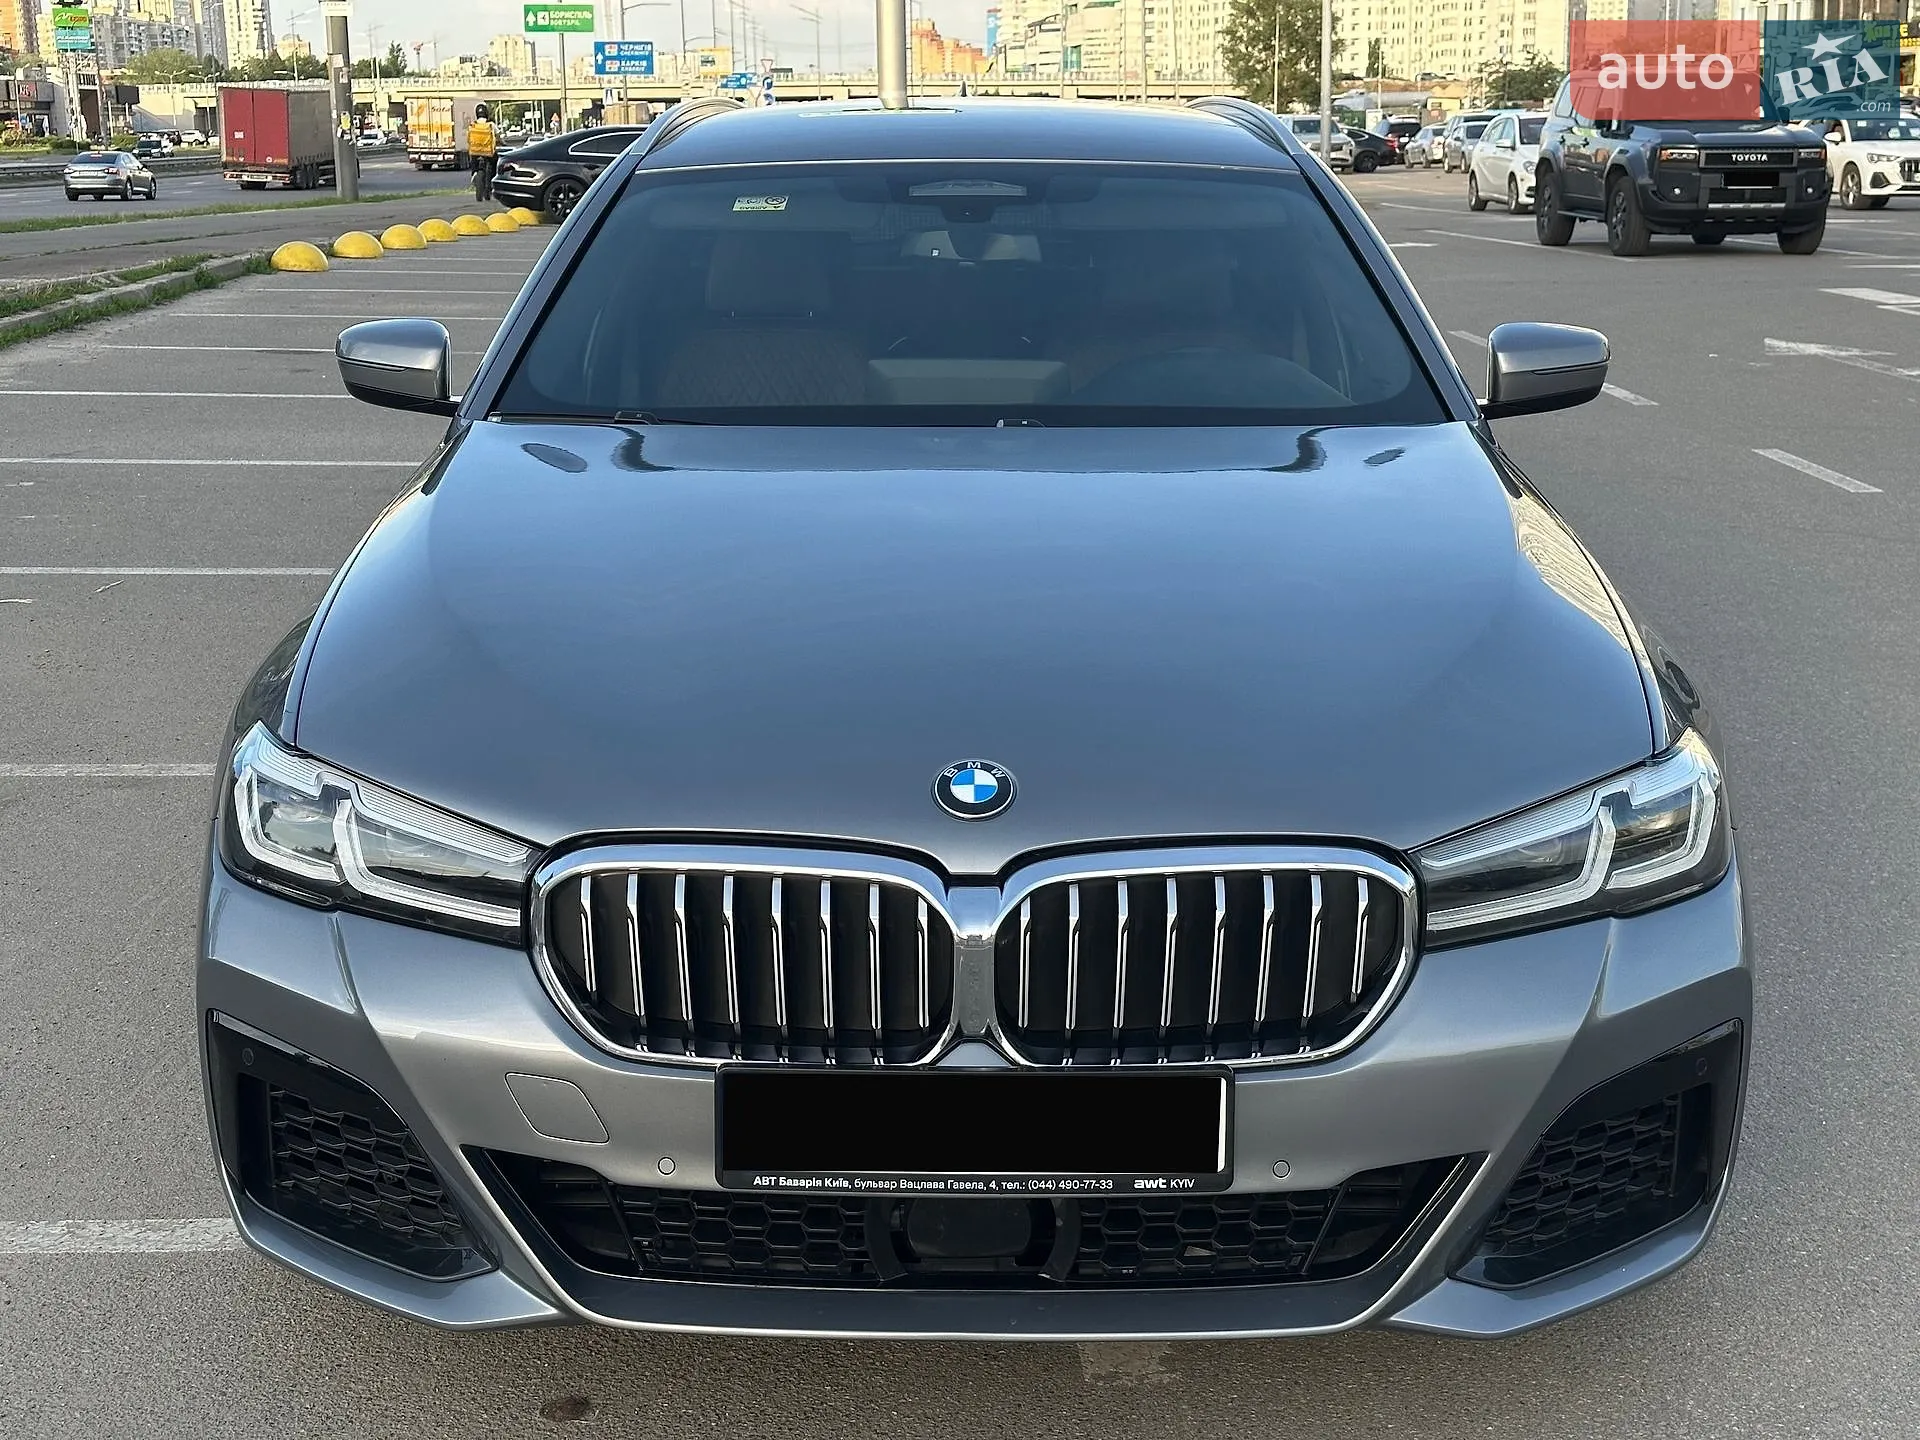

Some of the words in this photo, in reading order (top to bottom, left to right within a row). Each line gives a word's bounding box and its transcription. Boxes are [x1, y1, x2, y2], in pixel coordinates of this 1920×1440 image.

[1731, 153, 1768, 162] TOYOTA
[944, 761, 1006, 779] BMW
[753, 1176, 777, 1187] АВТ
[778, 1177, 822, 1189] Баварія
[824, 1178, 852, 1190] Київ,
[854, 1178, 898, 1191] бульвар
[899, 1180, 945, 1191] Вацлава
[947, 1180, 987, 1191] Гавела,
[989, 1181, 999, 1190] 4,
[1001, 1181, 1026, 1190] тел.:
[1028, 1180, 1057, 1190] (044)
[1058, 1180, 1113, 1190] 490-77-33
[1133, 1178, 1167, 1189] awt
[1170, 1179, 1196, 1189] KYIV
